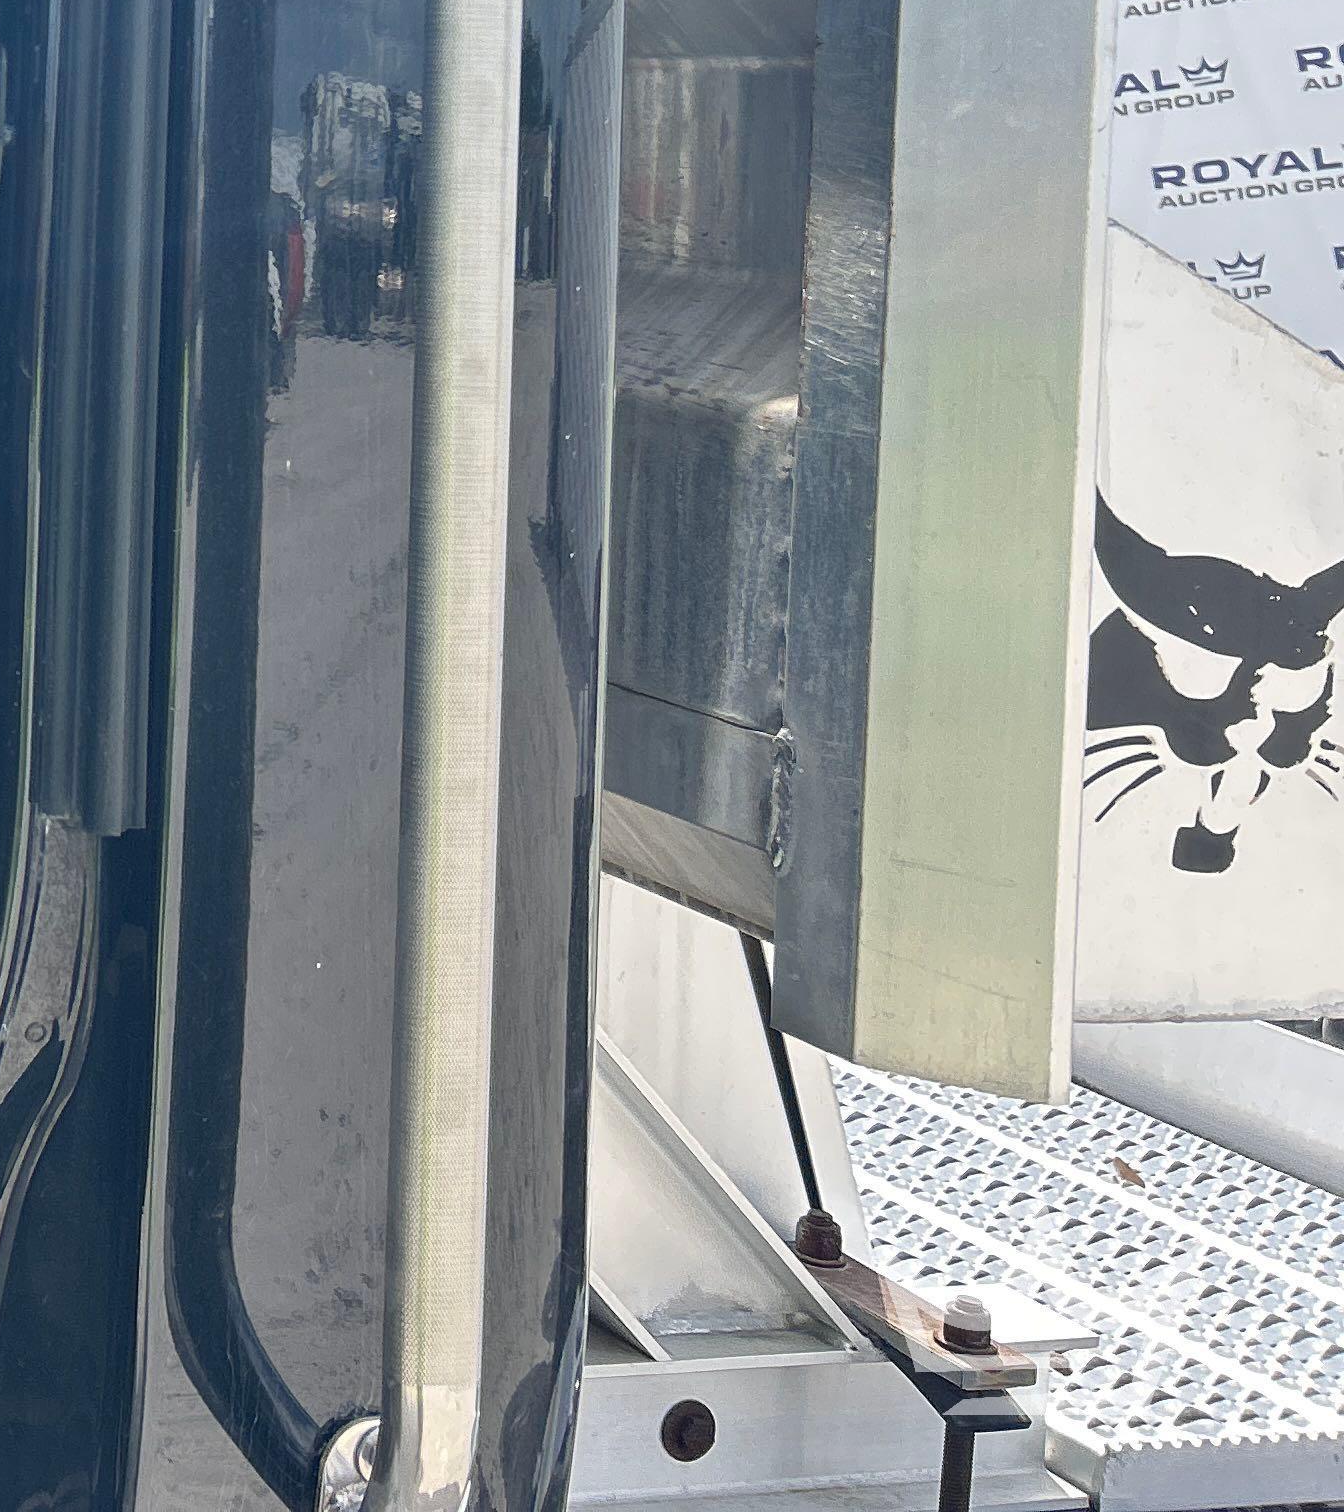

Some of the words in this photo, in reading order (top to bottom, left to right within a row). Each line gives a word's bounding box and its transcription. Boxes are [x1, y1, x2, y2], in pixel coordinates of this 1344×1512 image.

[1134, 88, 1235, 115] GROUP
[1150, 147, 1344, 190] ROYAL
[1158, 182, 1289, 210] AUCTION
